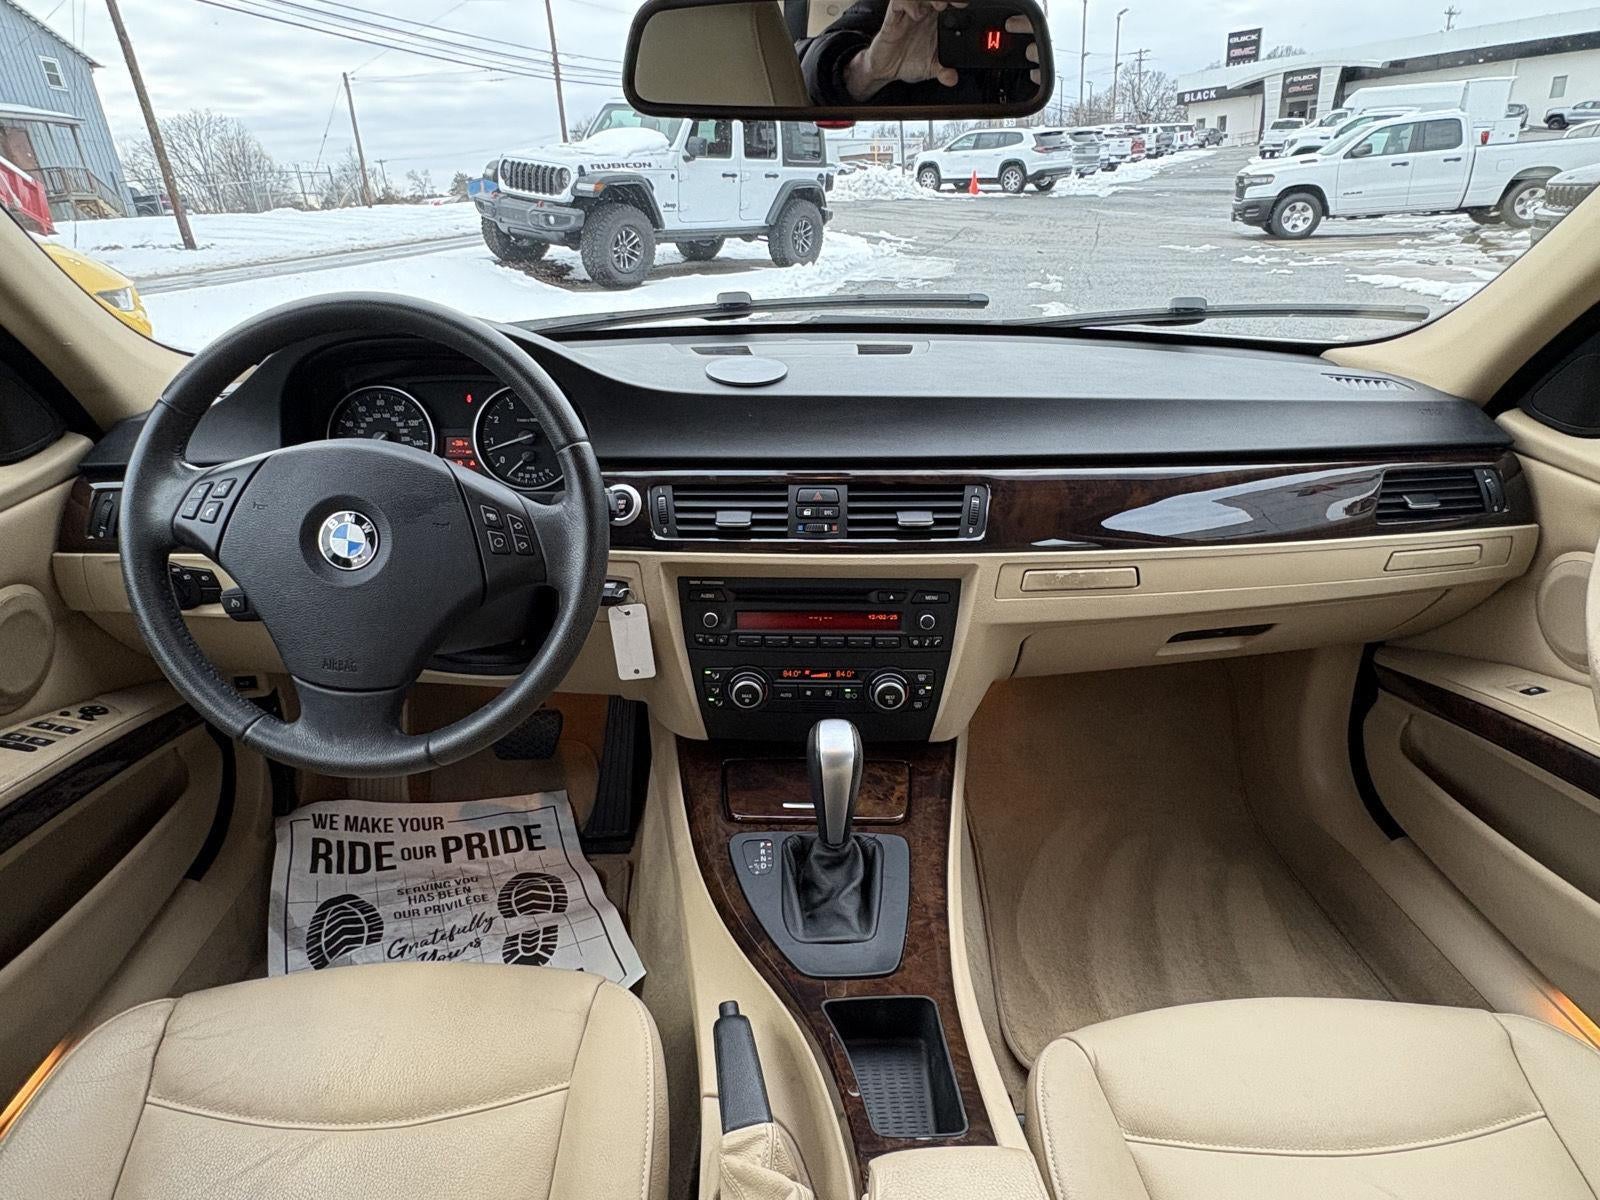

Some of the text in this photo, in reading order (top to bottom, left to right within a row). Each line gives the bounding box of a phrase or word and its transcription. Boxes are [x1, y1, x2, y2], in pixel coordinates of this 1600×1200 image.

[987, 31, 1000, 49] W
[1229, 33, 1259, 44] BUICK
[1230, 46, 1256, 57] GMC
[1293, 72, 1319, 82] BUICK
[1288, 84, 1313, 93] GMC
[1183, 89, 1217, 103] BLACK
[590, 162, 652, 170] RUBICON
[508, 402, 514, 410] 3
[493, 416, 500, 424] 2
[500, 456, 506, 464] 0
[327, 512, 374, 534] BMW
[322, 658, 357, 672] AIRBAG
[312, 813, 445, 833] WE MAKE YOUR
[309, 824, 547, 875] RIDE OUR PRIDE
[397, 876, 478, 896] SERVING YOU
[407, 886, 472, 905] HAS BEEN
[393, 893, 490, 920] OUR PRIVILEGE
[387, 911, 498, 960] Gratefully
